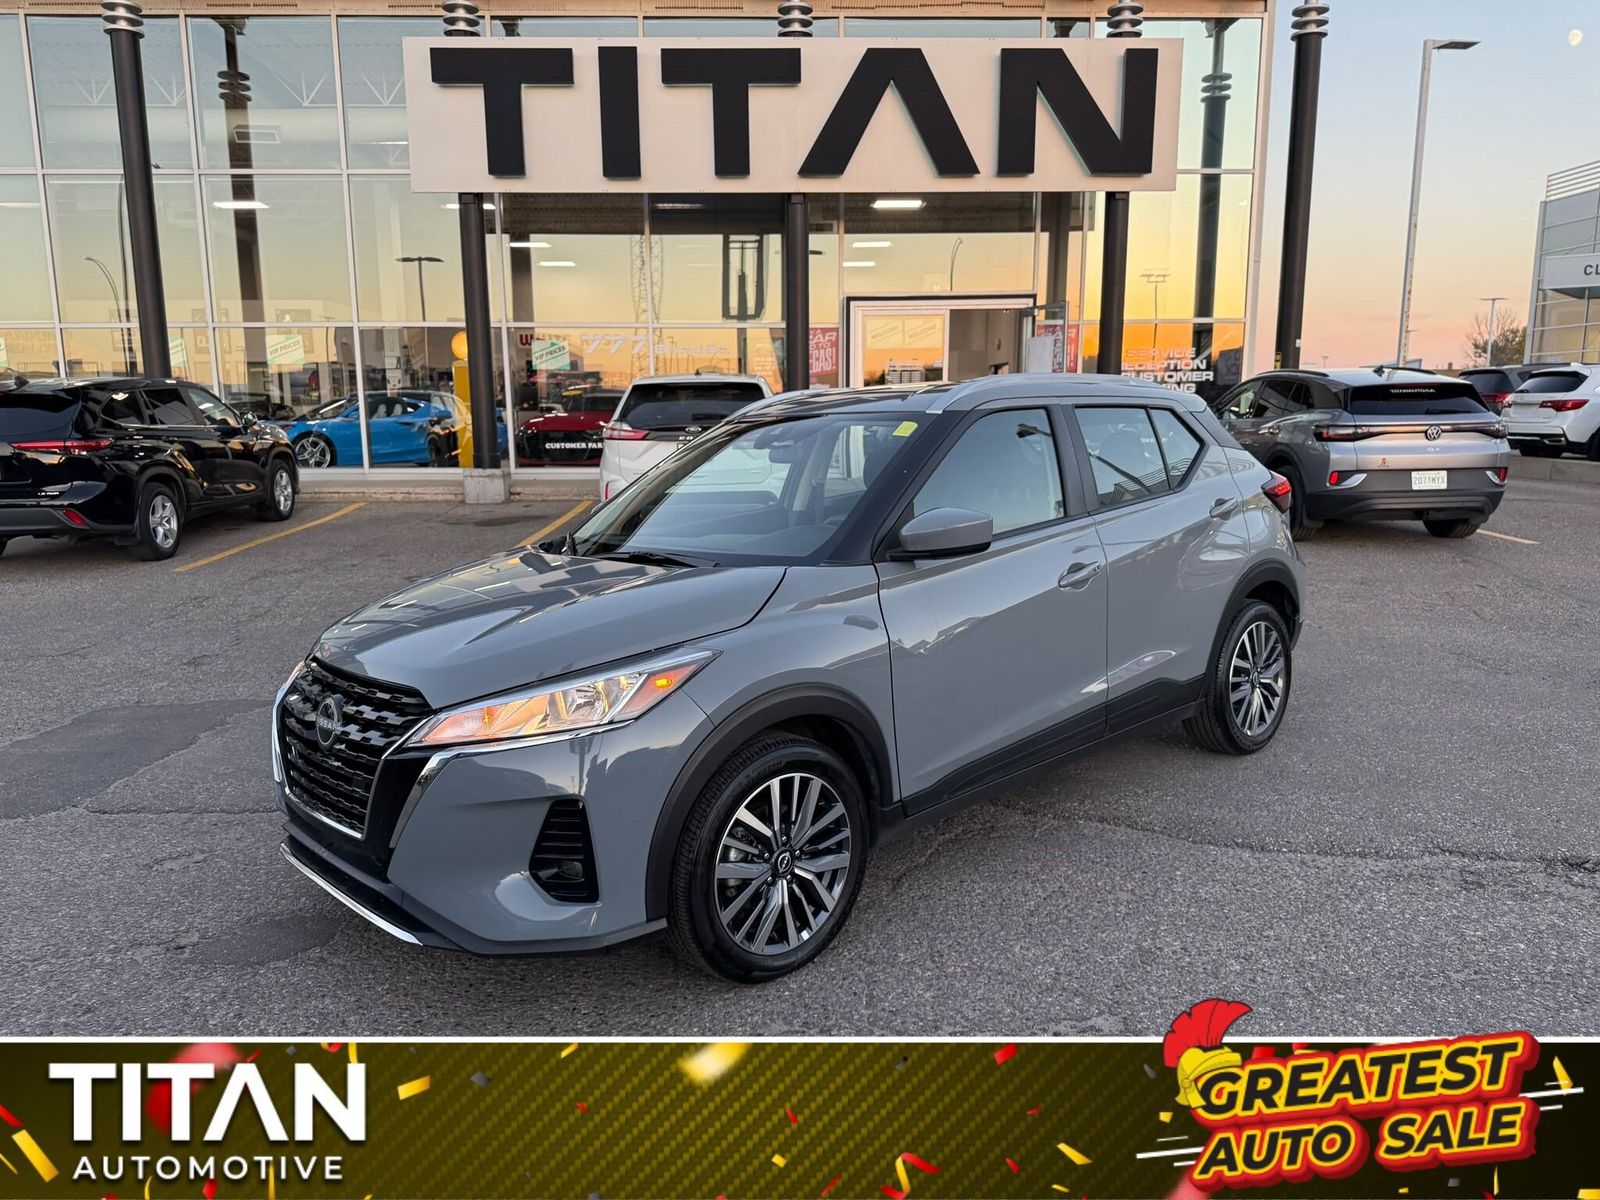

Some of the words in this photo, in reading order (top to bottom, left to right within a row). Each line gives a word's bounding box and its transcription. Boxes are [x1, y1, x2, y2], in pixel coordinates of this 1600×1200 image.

[430, 46, 1160, 178] TITAN
[580, 334, 649, 353] 777
[1126, 347, 1196, 358] SERVICE
[1122, 359, 1207, 371] ECEPTION
